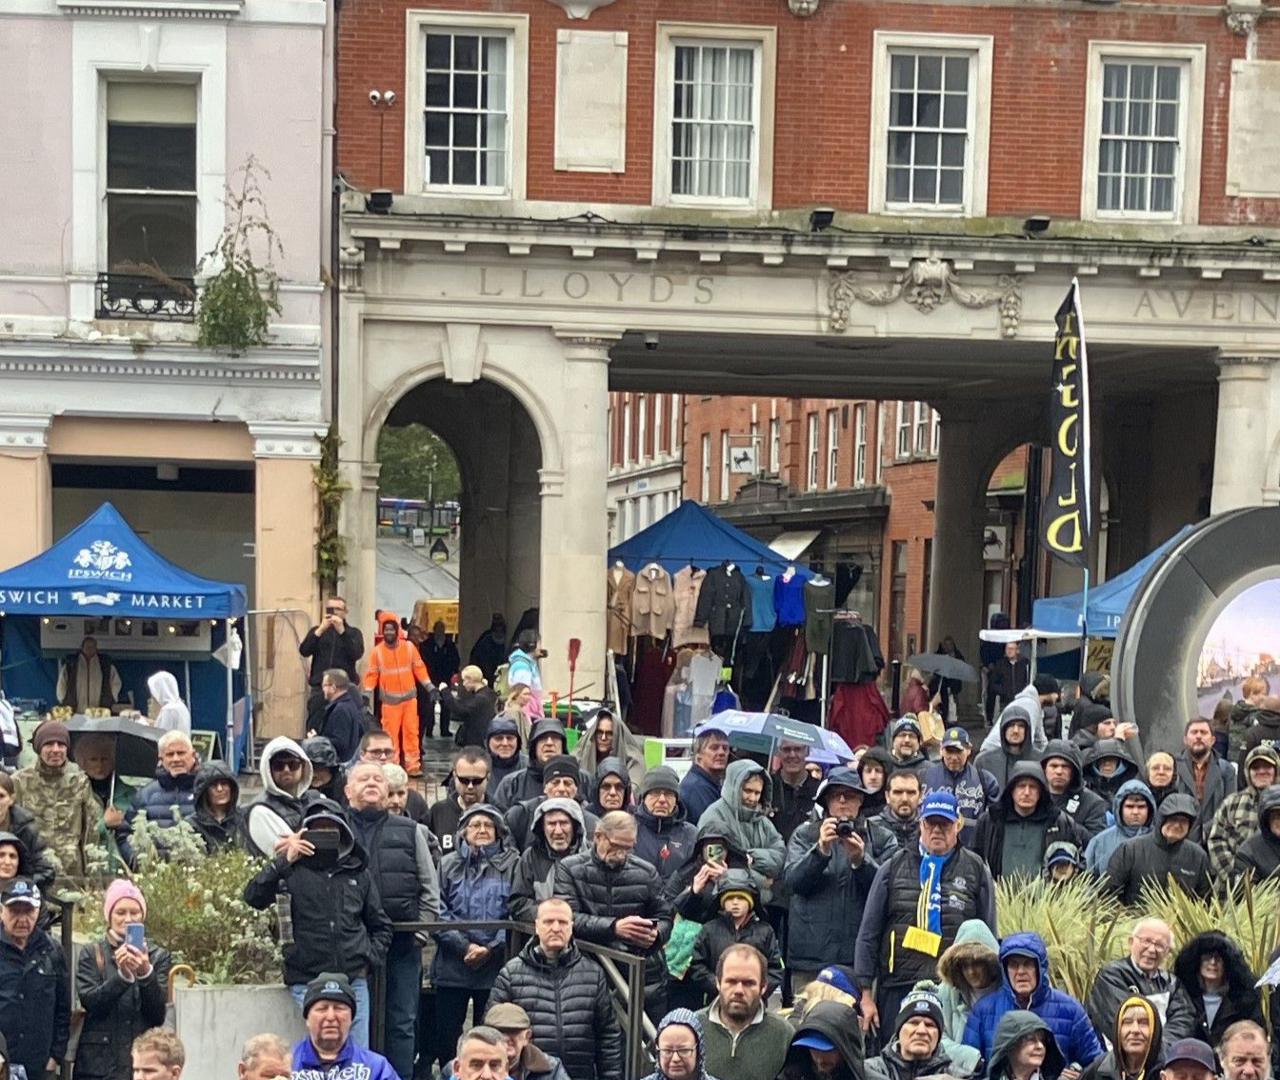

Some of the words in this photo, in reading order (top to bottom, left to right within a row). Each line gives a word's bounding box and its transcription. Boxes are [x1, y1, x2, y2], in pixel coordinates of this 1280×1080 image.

[478, 267, 715, 304] LLOYDS
[68, 568, 132, 581] IPSWICH
[131, 594, 206, 608] MARKET
